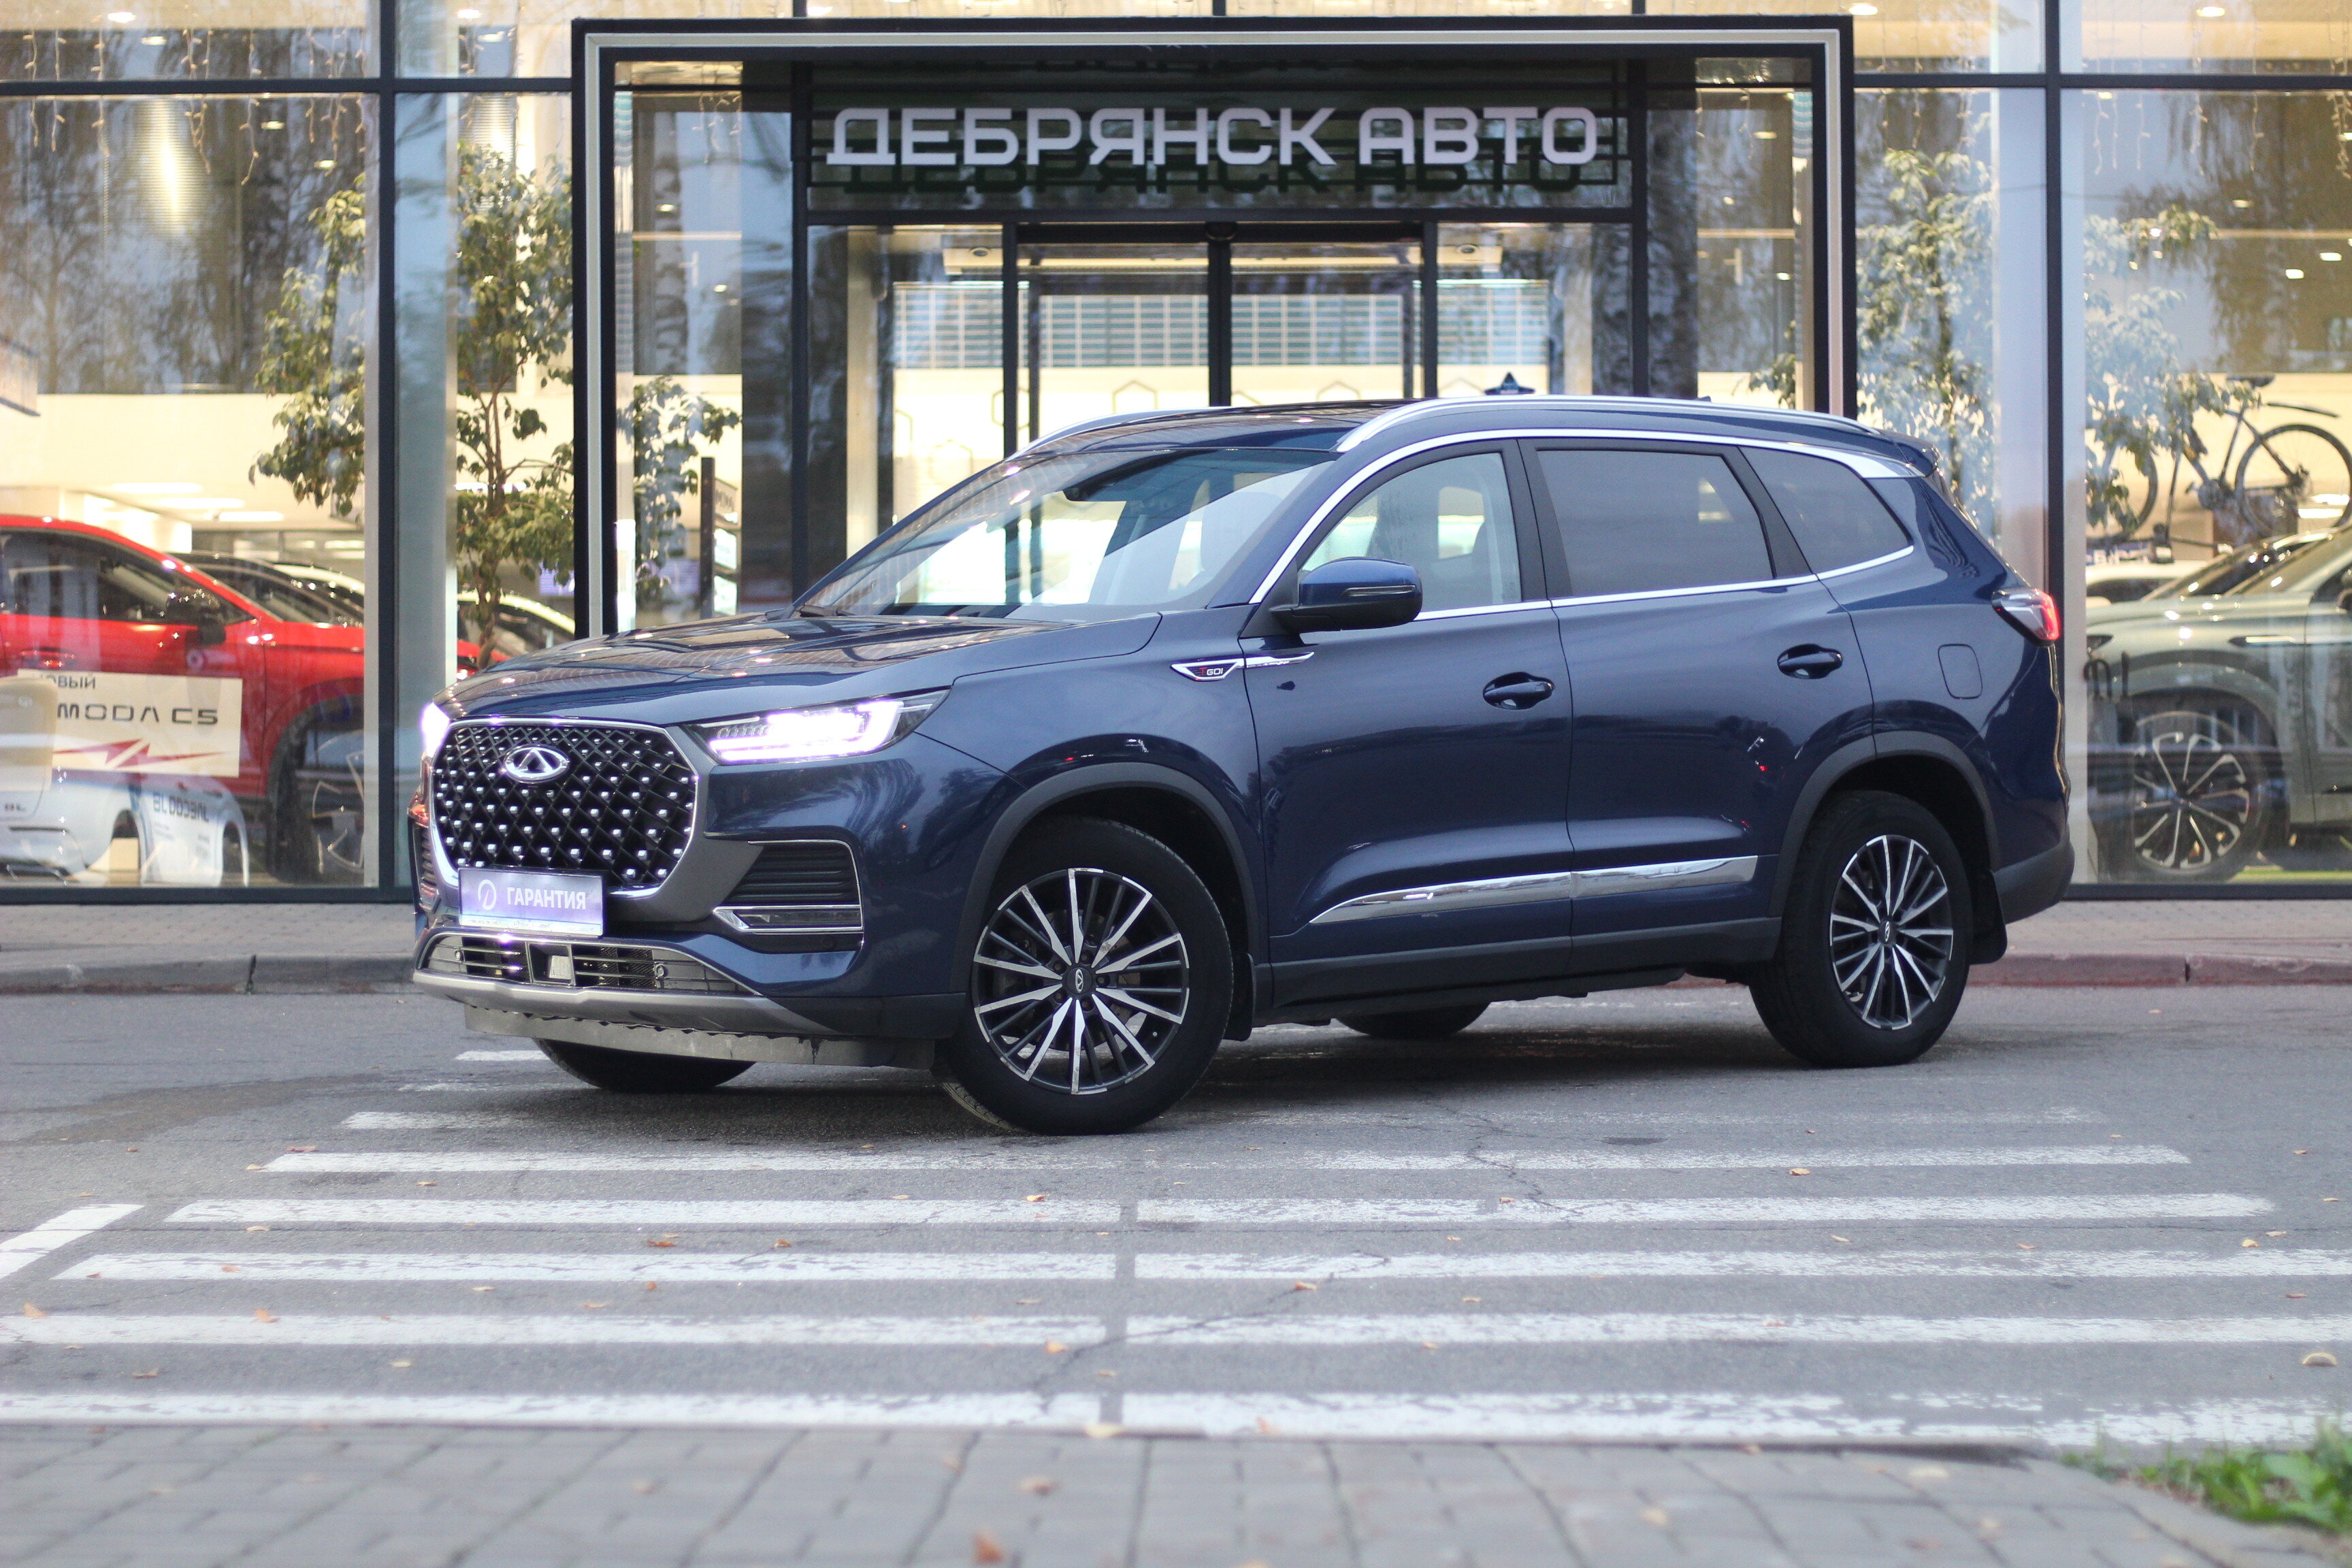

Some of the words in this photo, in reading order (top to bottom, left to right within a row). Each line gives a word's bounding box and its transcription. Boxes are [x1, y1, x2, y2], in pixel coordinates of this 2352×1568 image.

[826, 107, 1337, 165] ДЕБРЯНСК
[1359, 106, 1597, 165] АВТО
[42, 672, 96, 689] ВЫЙ
[57, 702, 161, 723] MODA
[171, 707, 218, 725] C5
[506, 886, 587, 911] ГАРАНТИЯ
